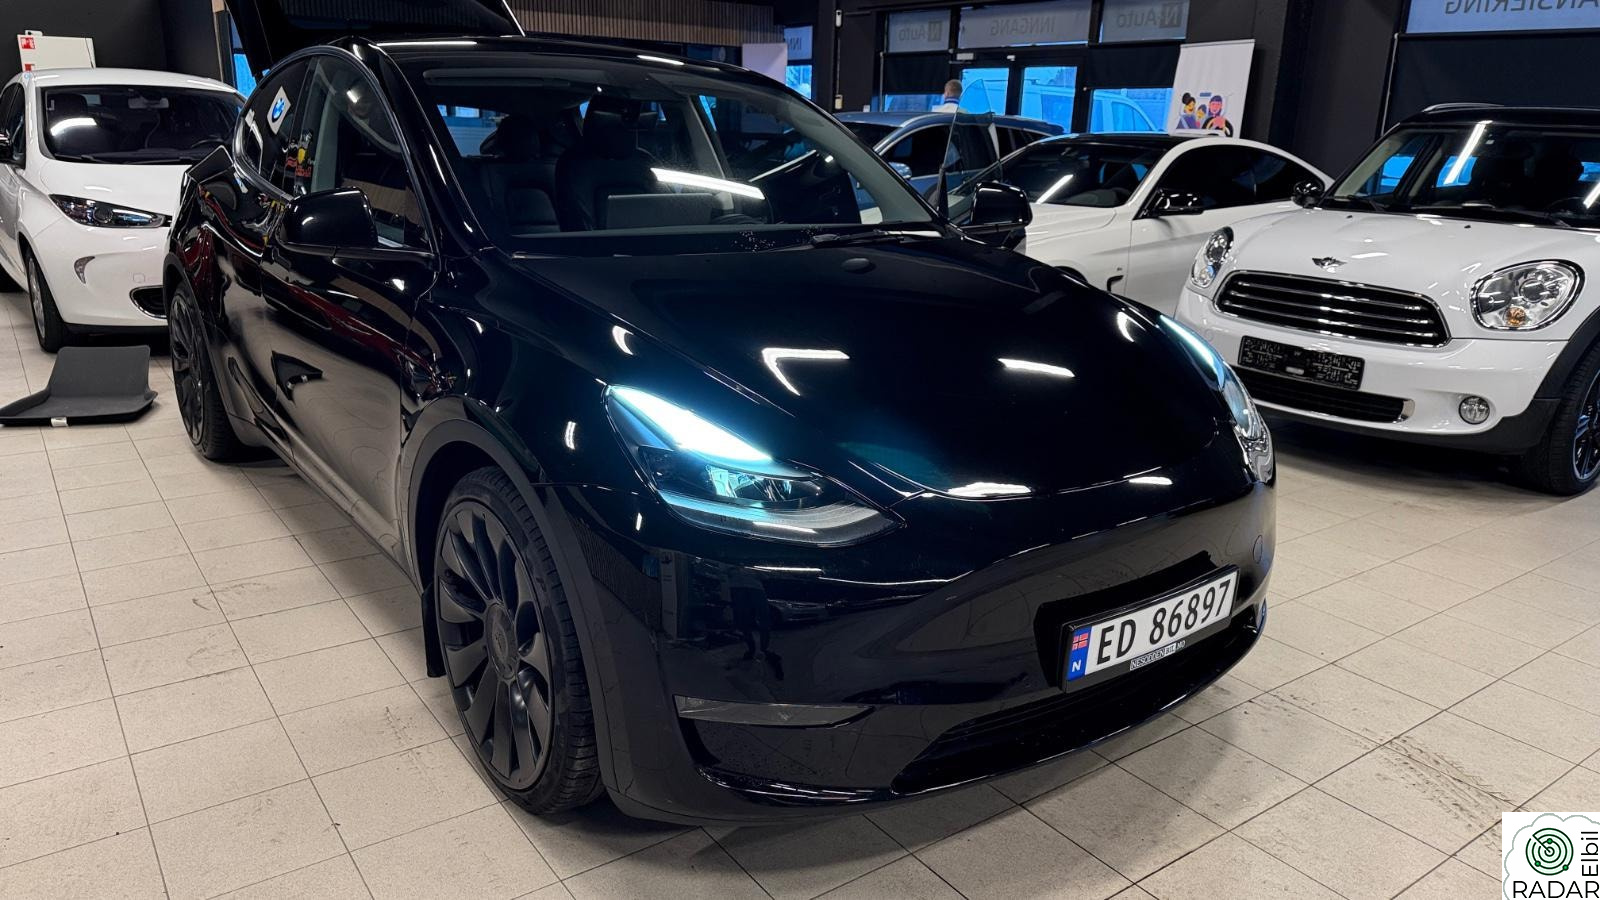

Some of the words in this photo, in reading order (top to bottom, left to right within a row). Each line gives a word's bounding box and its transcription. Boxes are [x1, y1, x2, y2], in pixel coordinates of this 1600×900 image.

[1096, 618, 1137, 666] ED
[1149, 578, 1232, 646] 86897
[1071, 659, 1082, 673] N
